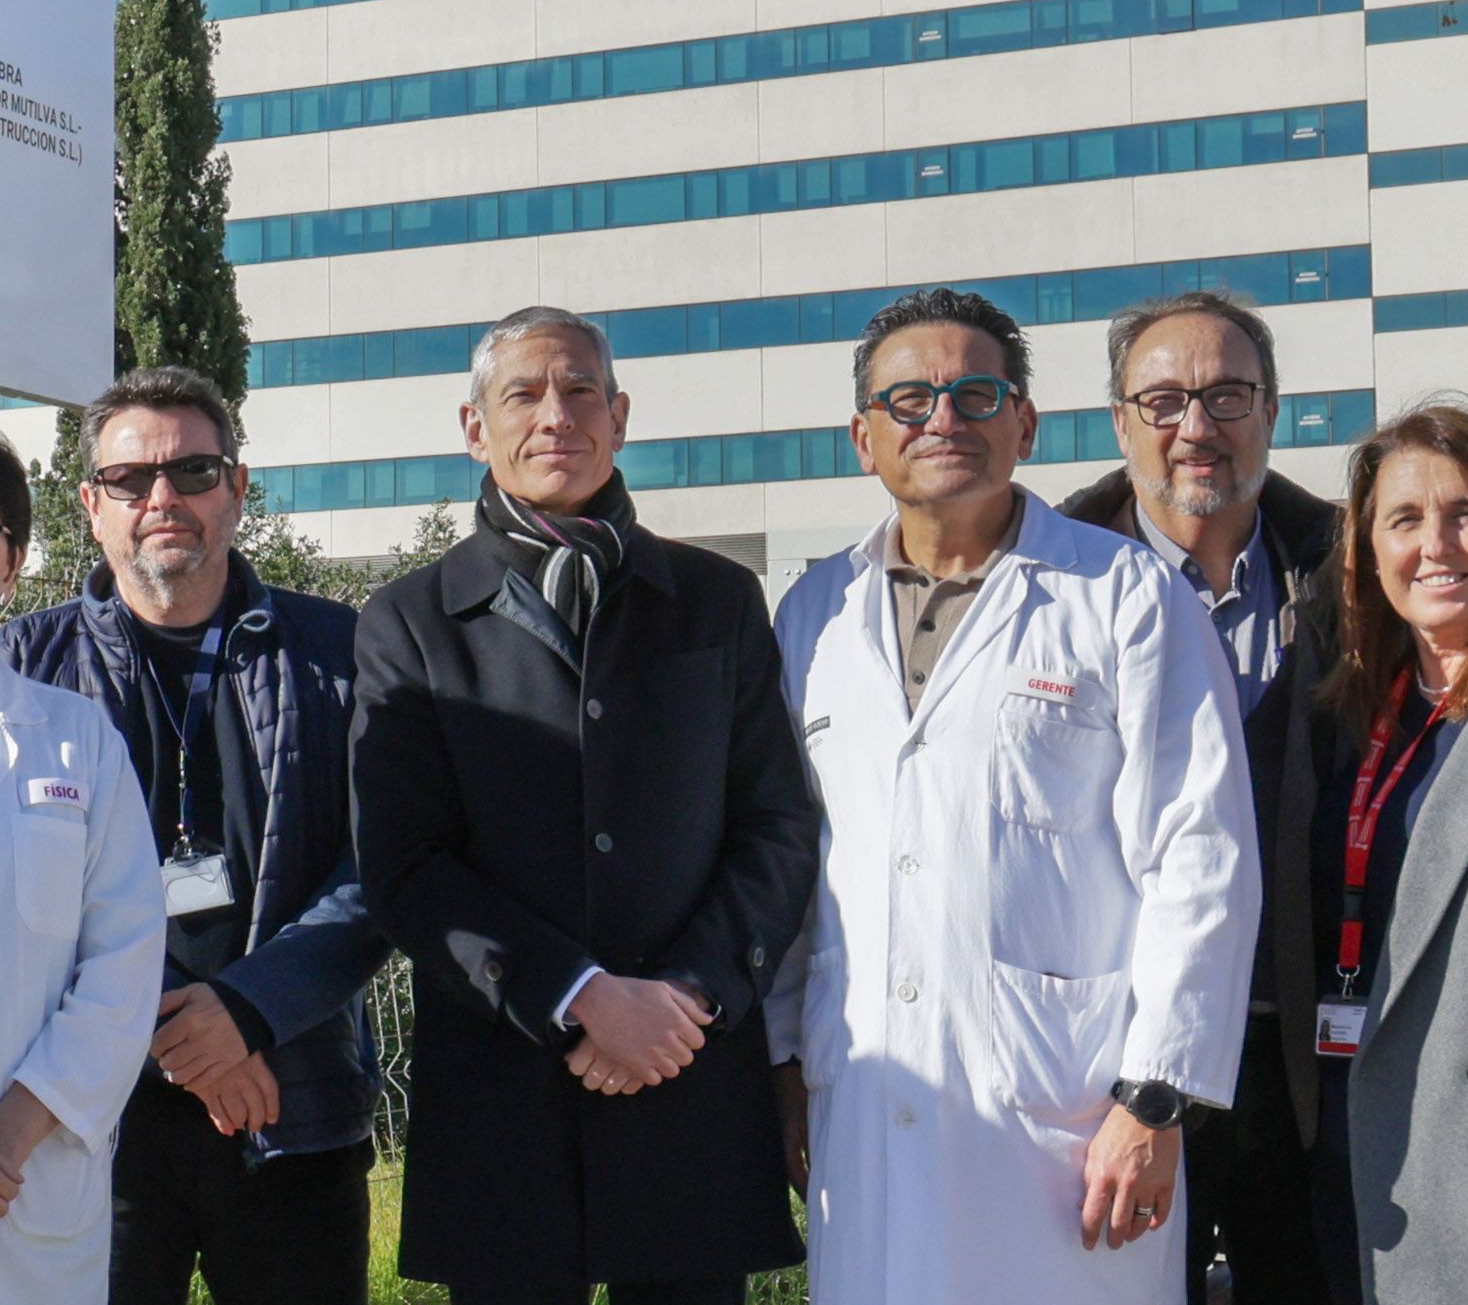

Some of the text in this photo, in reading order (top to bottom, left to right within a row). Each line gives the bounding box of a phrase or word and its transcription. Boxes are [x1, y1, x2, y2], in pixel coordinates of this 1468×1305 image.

[11, 92, 58, 128] MUTILVA
[58, 138, 84, 168] S.L.)
[1027, 677, 1077, 698] GERENTE
